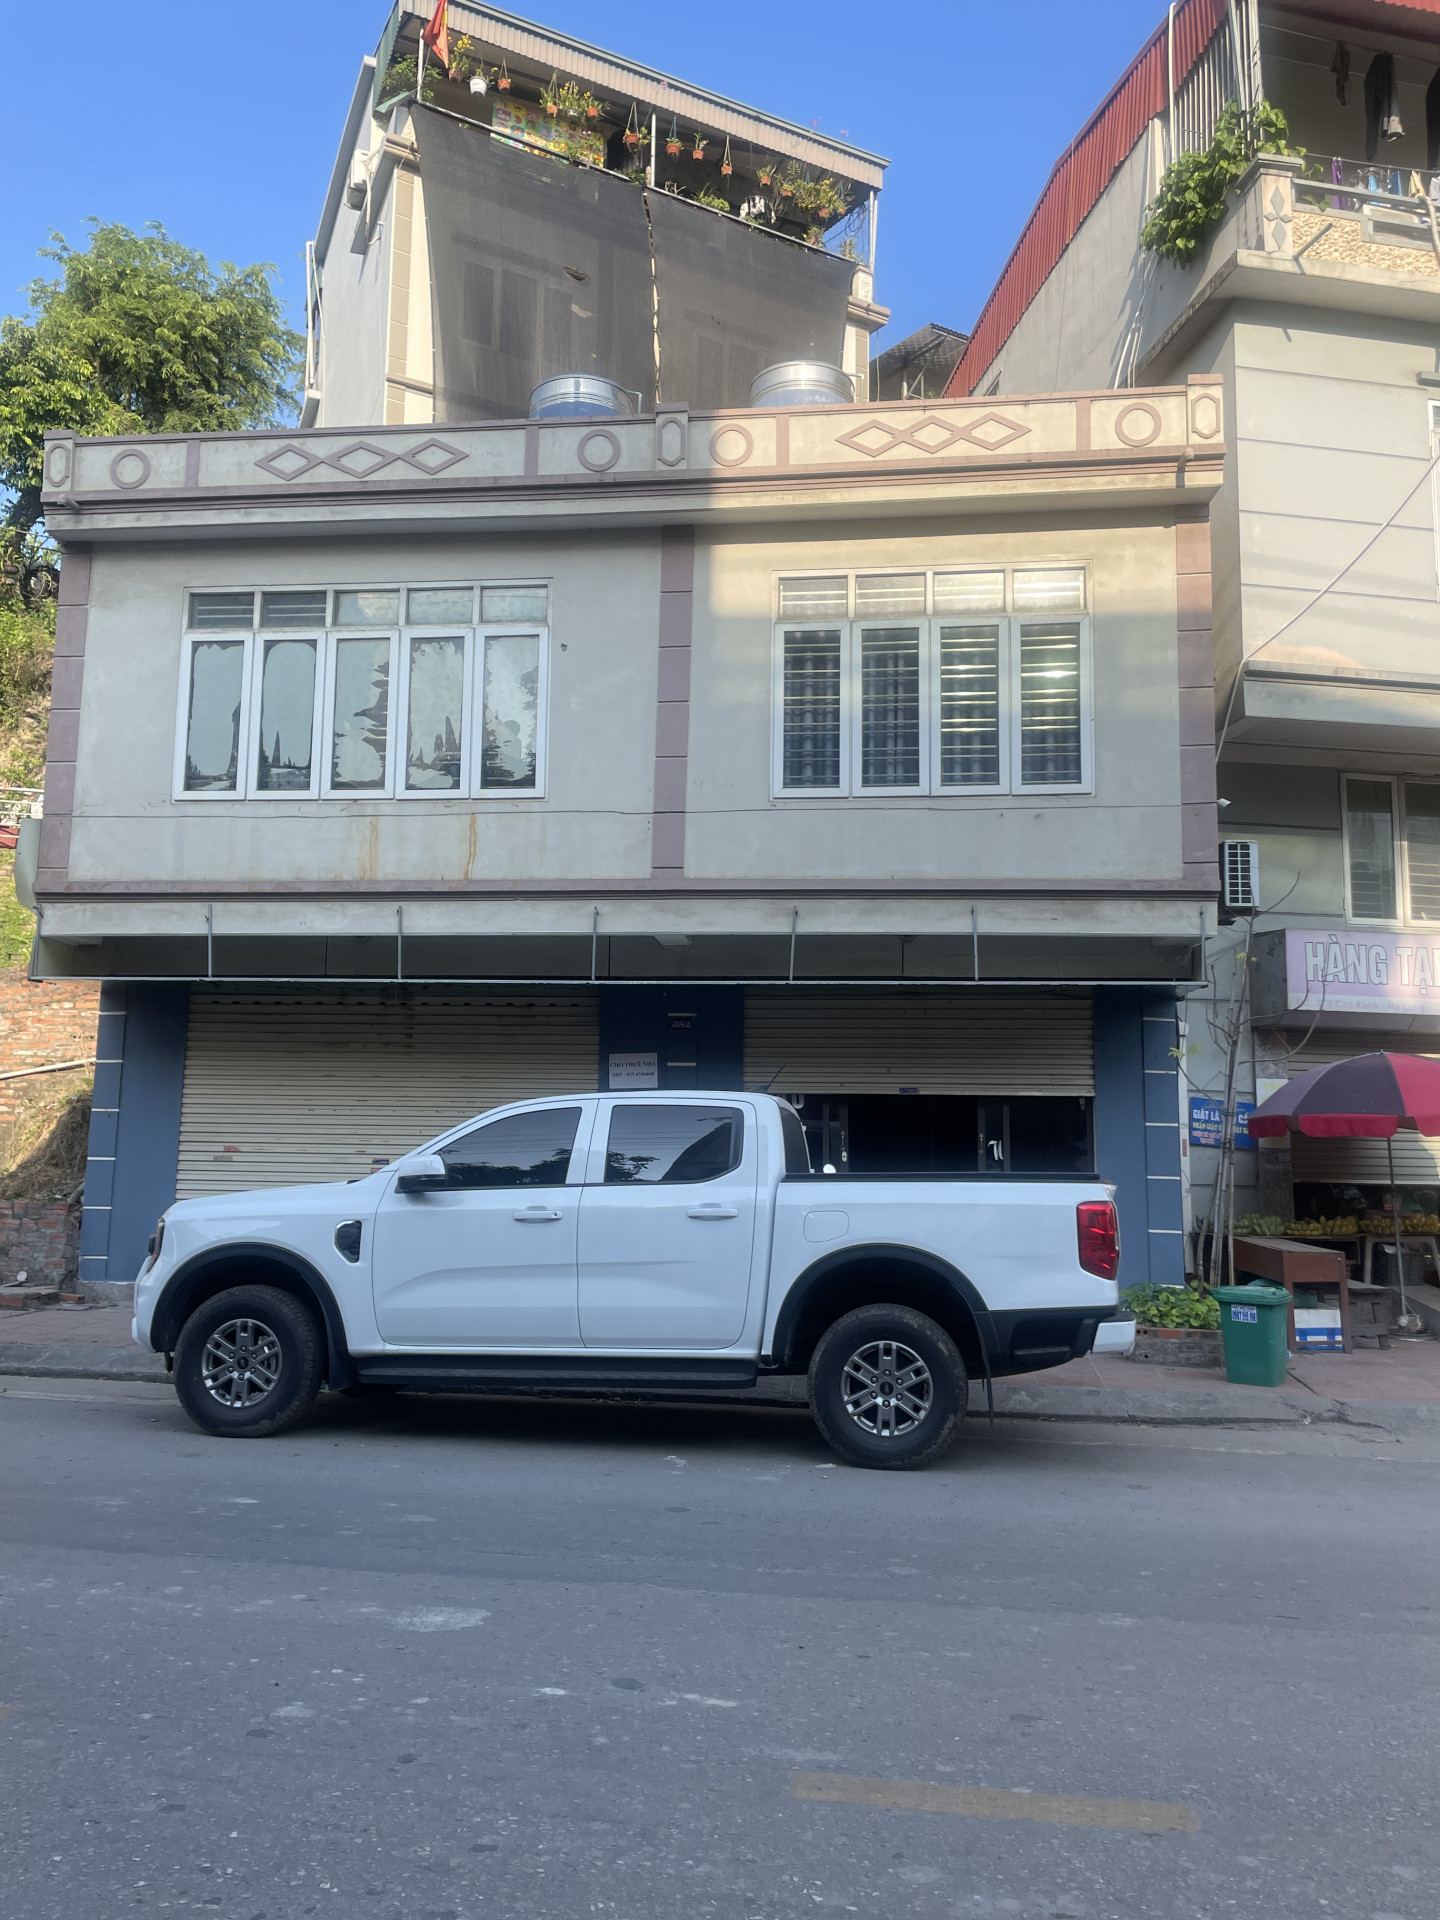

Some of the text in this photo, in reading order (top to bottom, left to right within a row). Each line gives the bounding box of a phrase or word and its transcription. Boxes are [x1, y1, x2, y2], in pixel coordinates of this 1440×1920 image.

[1304, 933, 1389, 985] HÀNG
[1192, 1108, 1209, 1122] GIẶT
[1210, 1109, 1220, 1122] LÀ
